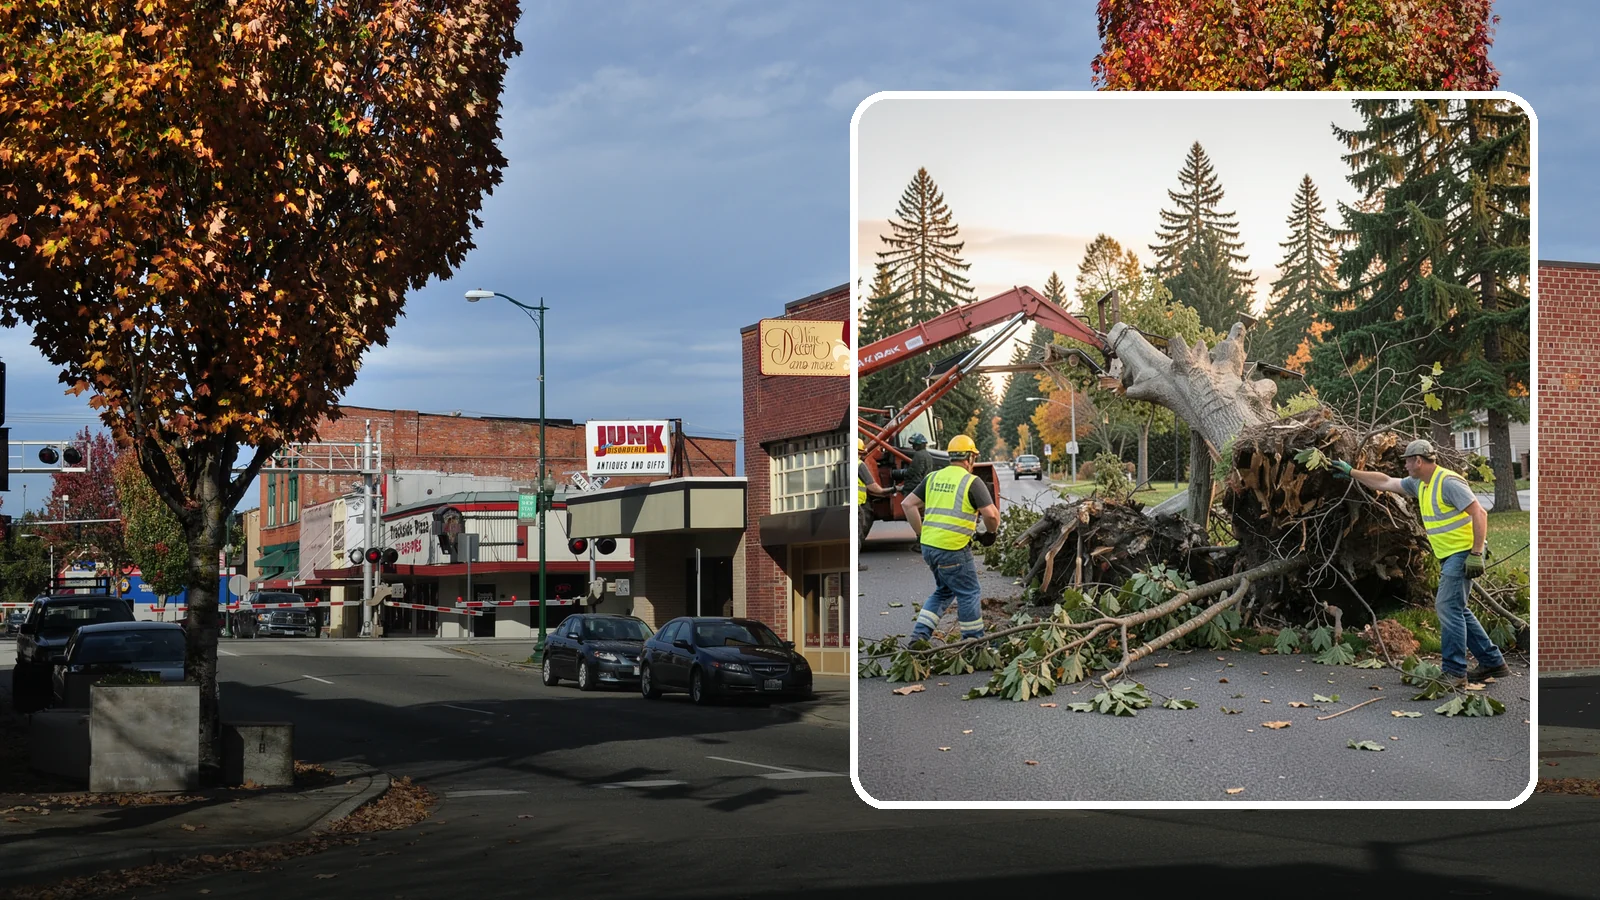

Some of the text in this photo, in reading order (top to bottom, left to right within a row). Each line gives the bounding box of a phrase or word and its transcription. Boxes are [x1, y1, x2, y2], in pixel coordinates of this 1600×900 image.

[595, 425, 665, 457] JUNK
[607, 446, 646, 454] DISORDERLY
[597, 460, 665, 470] ANTIQUES AND GIFTS
[390, 519, 429, 540] Trackside Pizza
